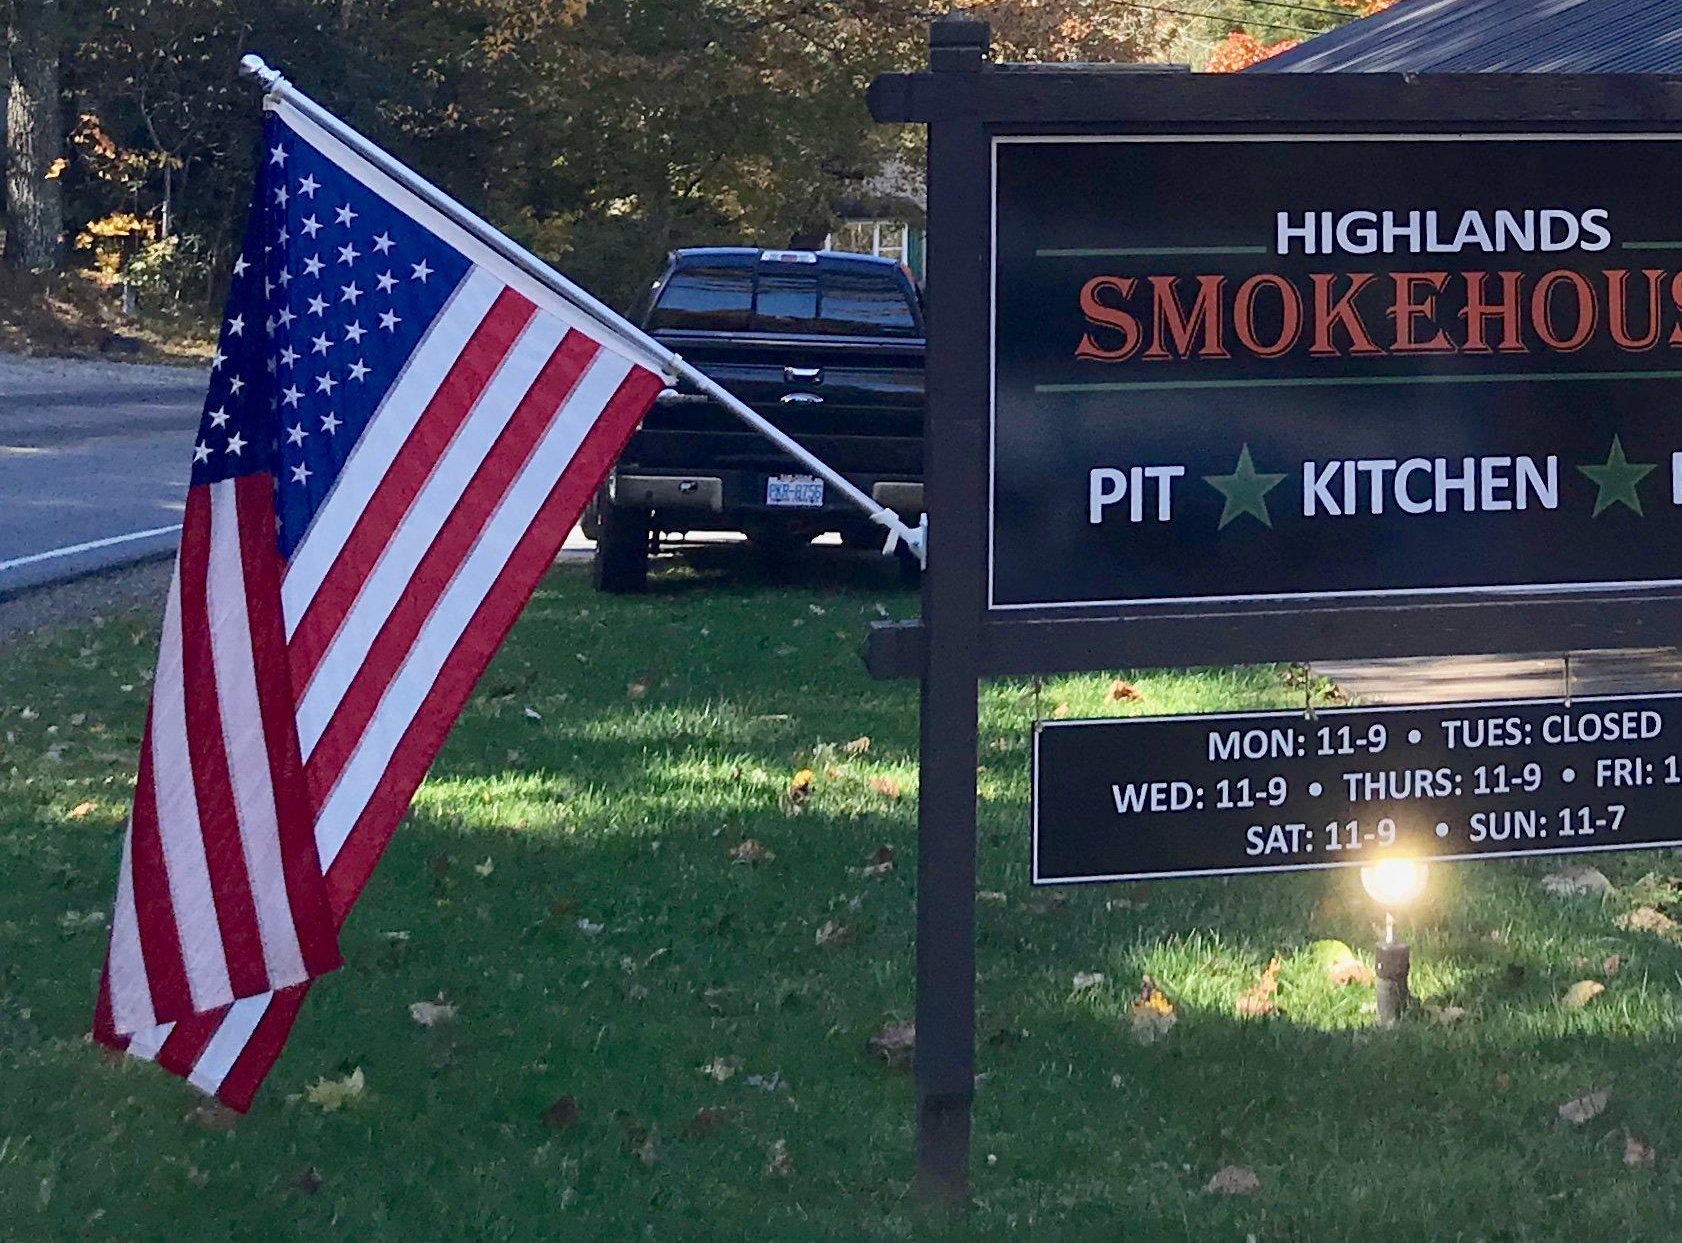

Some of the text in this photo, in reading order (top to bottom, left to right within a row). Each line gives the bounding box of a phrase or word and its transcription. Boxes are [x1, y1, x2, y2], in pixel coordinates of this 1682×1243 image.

[1276, 208, 1612, 255] HIGHLANDS
[1088, 464, 1186, 525] PIT
[1302, 454, 1559, 518] KITCHEN
[1207, 710, 1663, 762] MON: 11-9 TUES: CLOSED
[1111, 780, 1205, 814] WED:
[1215, 776, 1288, 809] 11-9
[1342, 767, 1463, 803] THURS:
[1473, 763, 1543, 795] 11-9
[1596, 757, 1654, 788] FRI:
[1245, 804, 1627, 856] SAT: 11-9 SUN: 11-7
